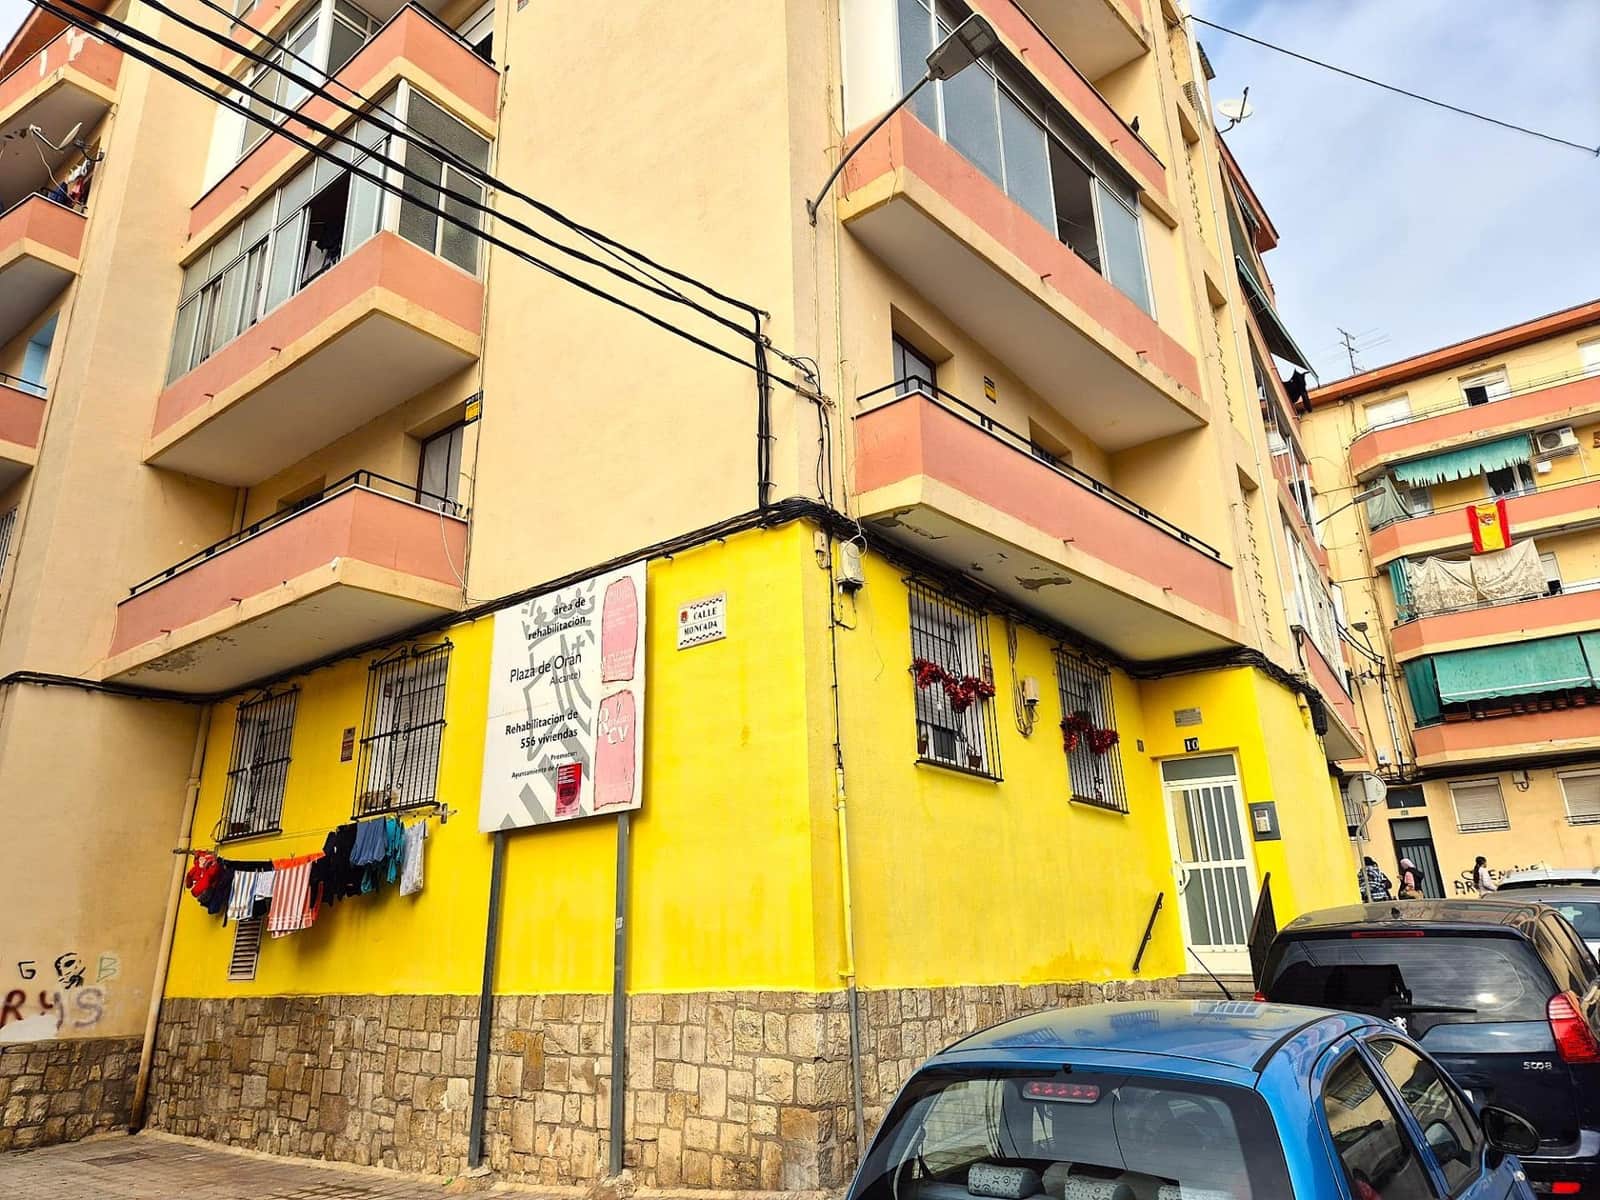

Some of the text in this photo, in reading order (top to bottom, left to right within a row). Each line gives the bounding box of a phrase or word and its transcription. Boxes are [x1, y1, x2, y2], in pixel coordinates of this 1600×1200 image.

[575, 597, 586, 609] de
[693, 607, 717, 621] CALLE
[528, 616, 586, 640] rehabilitación
[684, 620, 718, 635] MONCADA
[510, 652, 582, 683] Plaza de Orán
[505, 709, 578, 735] Rehabilitación de
[520, 727, 578, 749] 556 viviendas
[1186, 740, 1198, 750] 10
